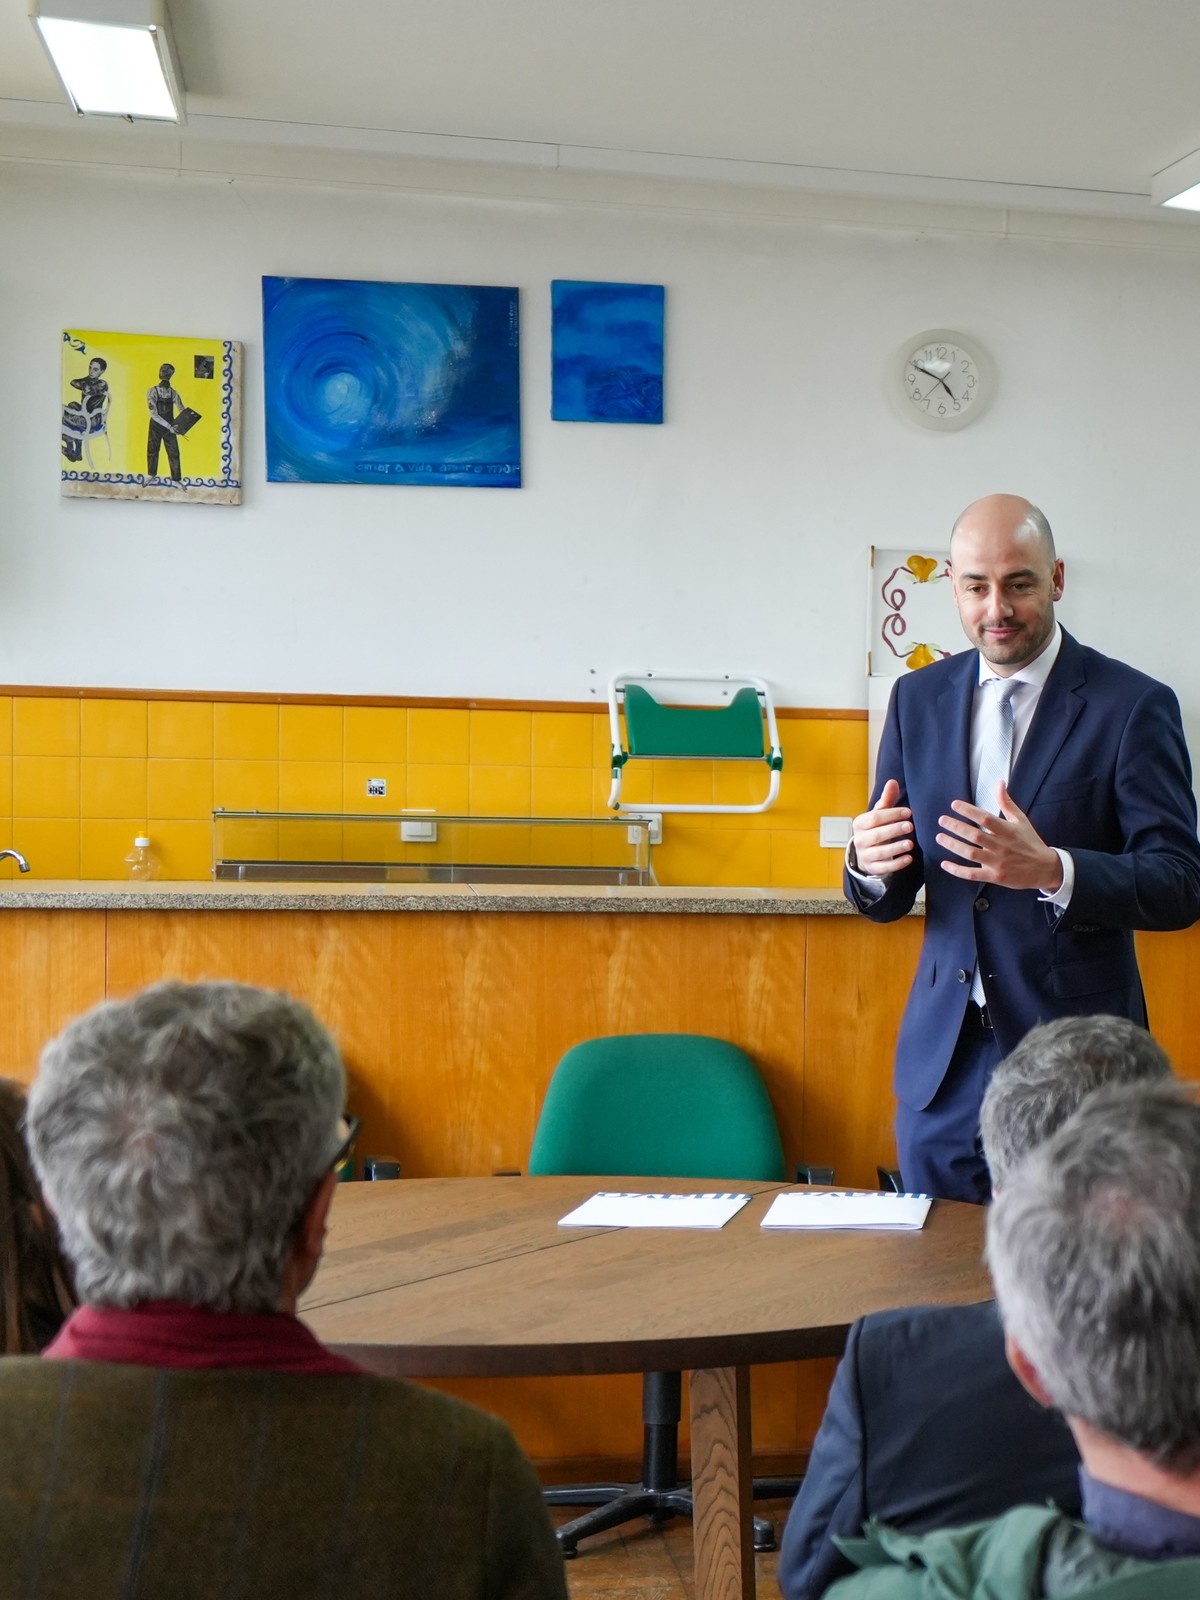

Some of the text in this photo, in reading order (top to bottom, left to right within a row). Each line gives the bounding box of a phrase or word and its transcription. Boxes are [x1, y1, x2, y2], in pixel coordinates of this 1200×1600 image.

[924, 350, 933, 361] 11
[936, 347, 947, 360] 12
[951, 351, 956, 362] 1
[961, 360, 970, 374] 2
[907, 373, 916, 386] 9
[966, 374, 975, 388] 3
[912, 388, 922, 401] 8
[962, 390, 970, 401] 4
[922, 398, 931, 410] 7
[937, 402, 947, 415] 6
[953, 399, 961, 411] 5
